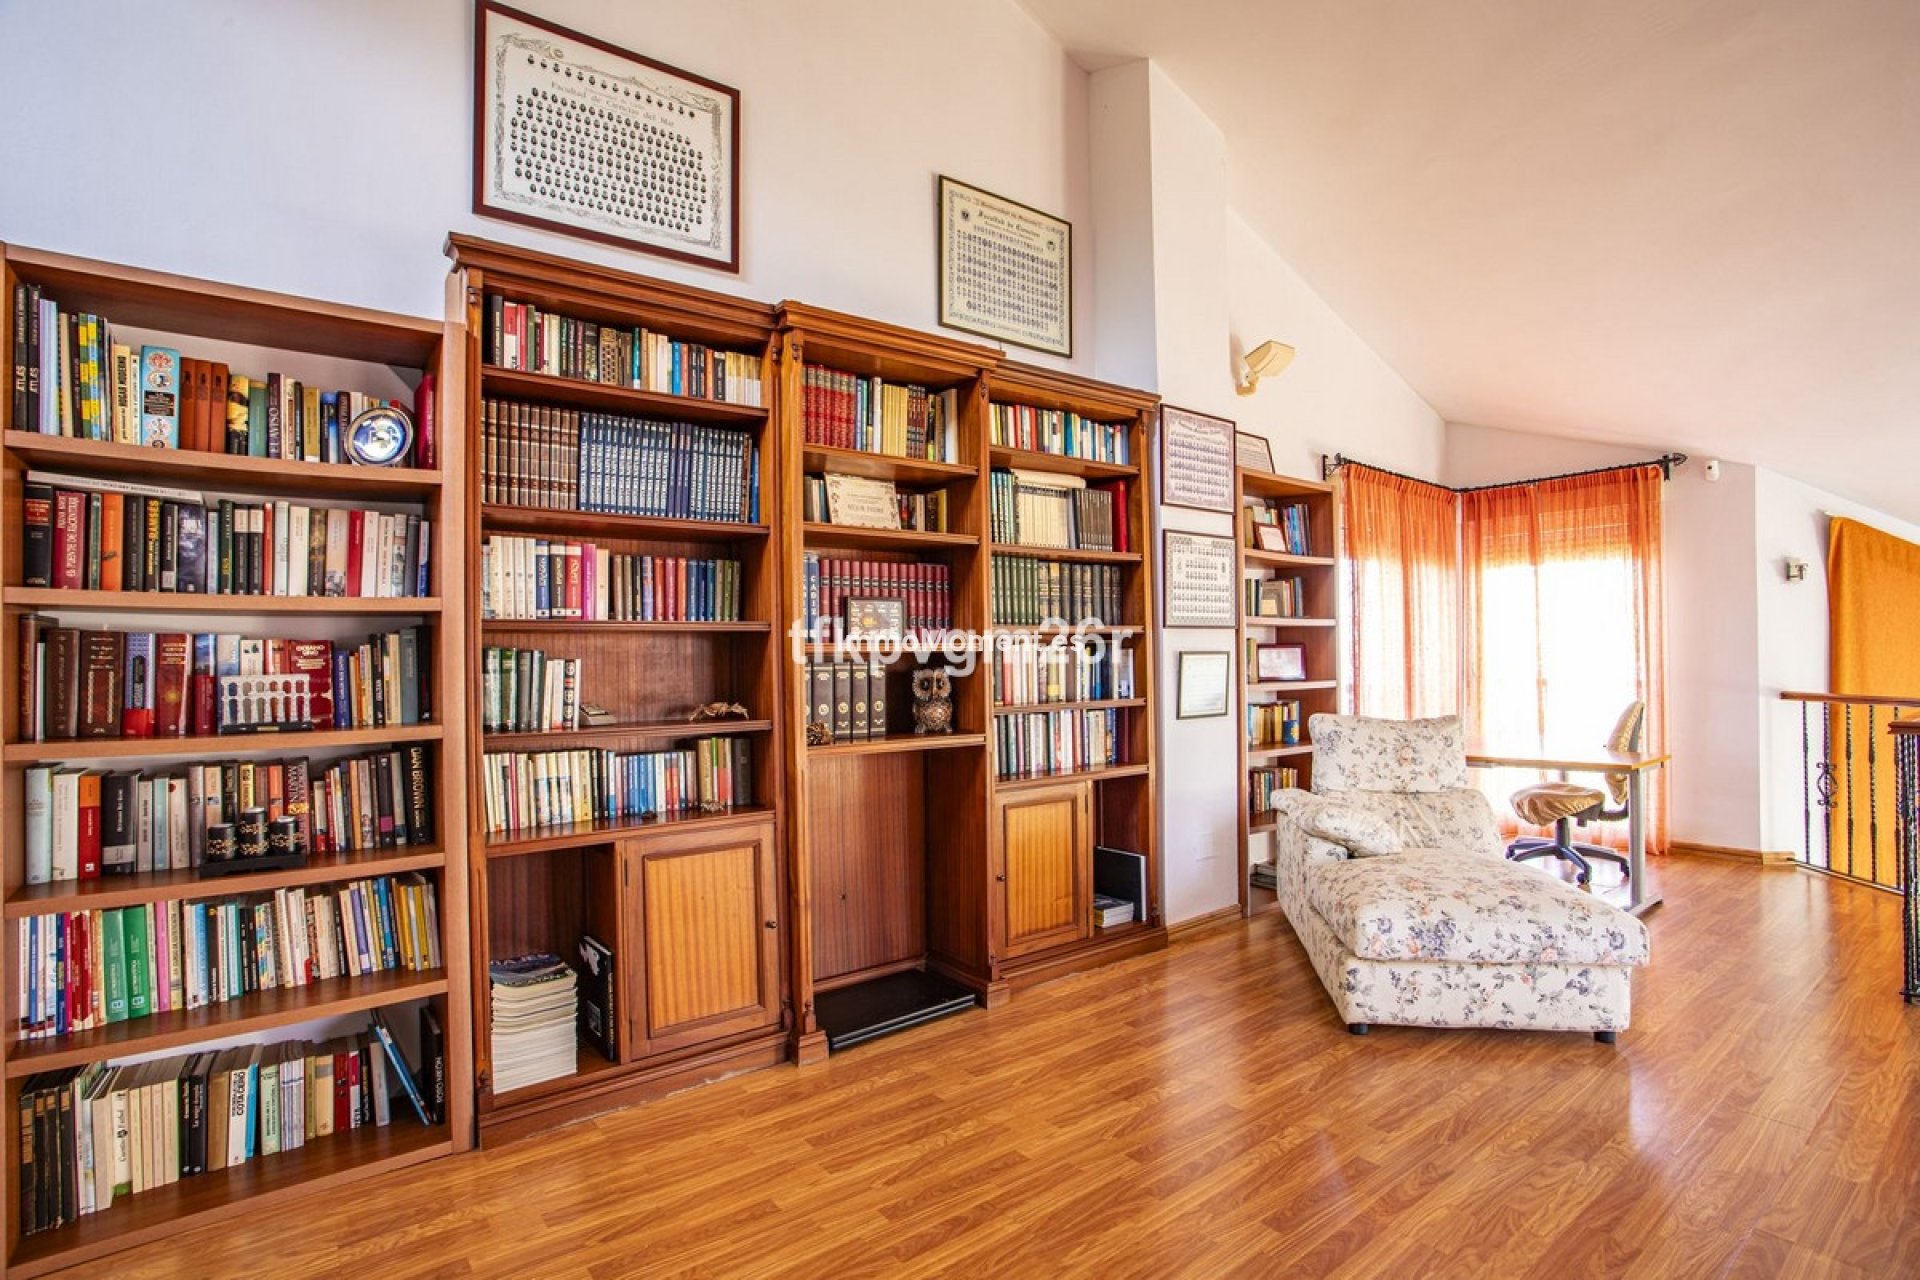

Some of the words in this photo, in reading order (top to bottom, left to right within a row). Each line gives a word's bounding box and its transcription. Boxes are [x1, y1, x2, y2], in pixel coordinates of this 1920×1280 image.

[15, 365, 26, 393] ATLAS
[29, 367, 39, 394] ATLAS
[411, 747, 423, 769] DAN
[412, 770, 425, 809] BROWN
